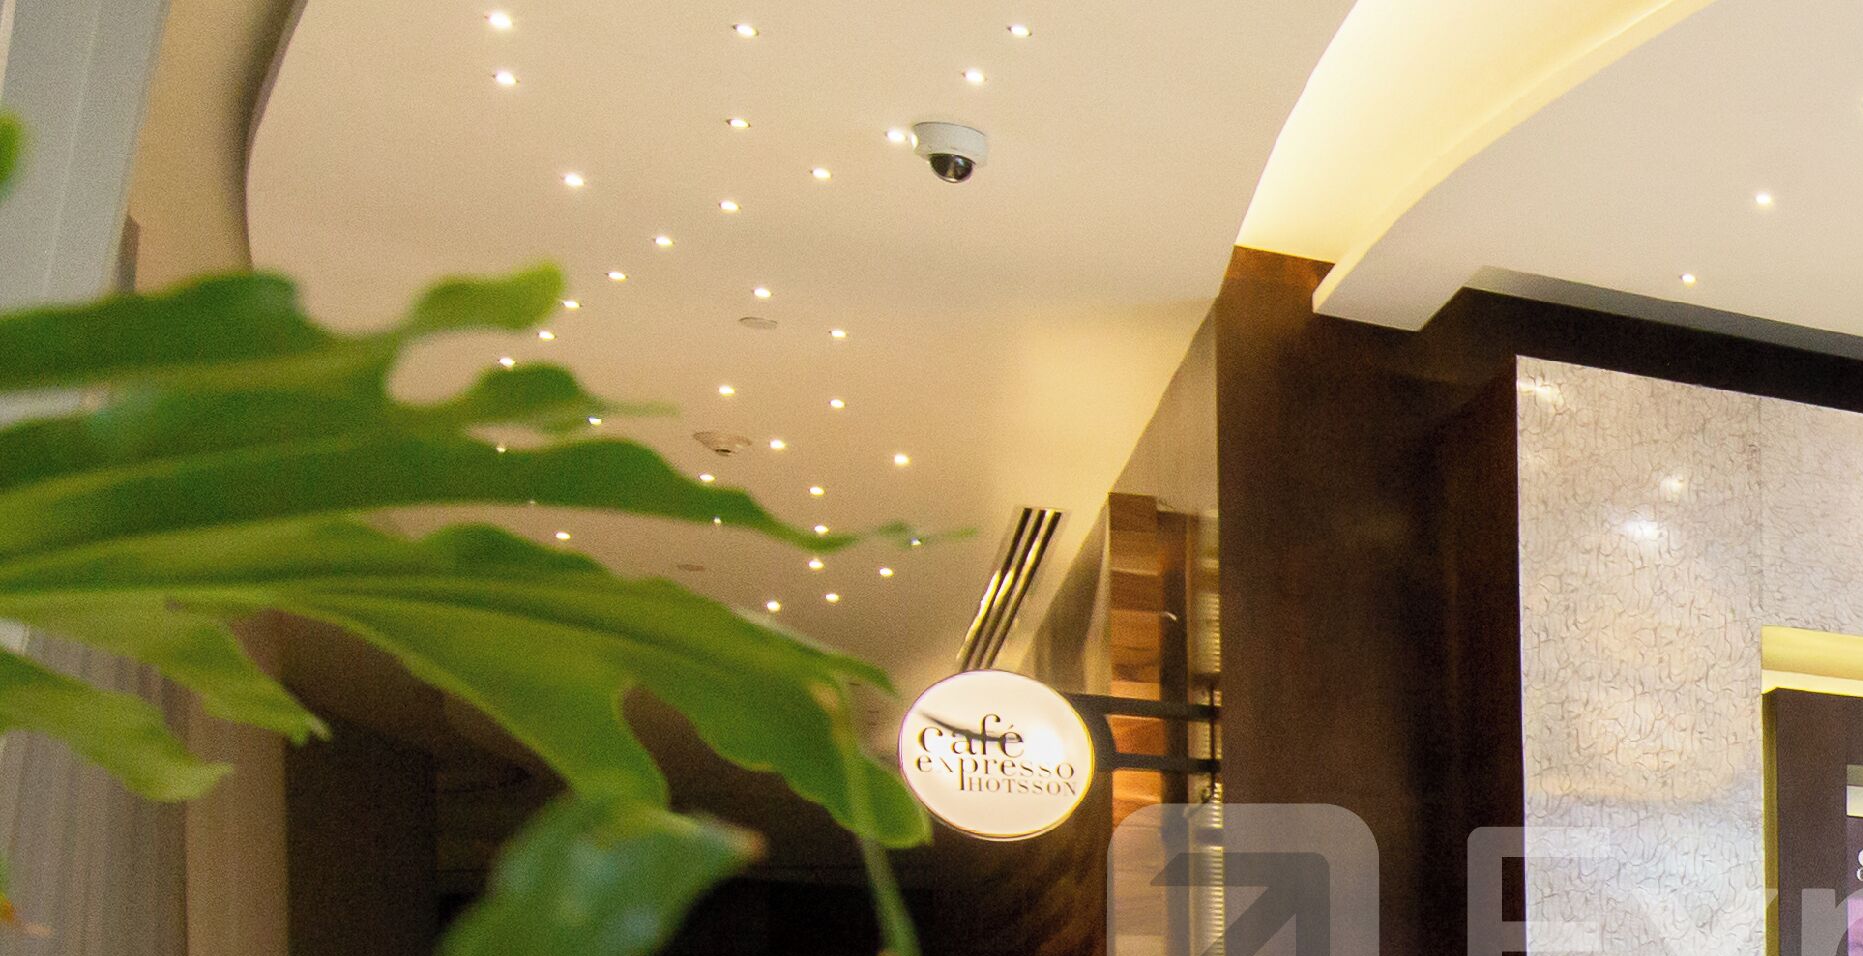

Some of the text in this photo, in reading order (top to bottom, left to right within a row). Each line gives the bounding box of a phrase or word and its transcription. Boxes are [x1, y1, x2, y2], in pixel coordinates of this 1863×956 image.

[917, 713, 1024, 759] café
[916, 753, 1075, 792] expresso
[967, 775, 1077, 797] HOTSSON
